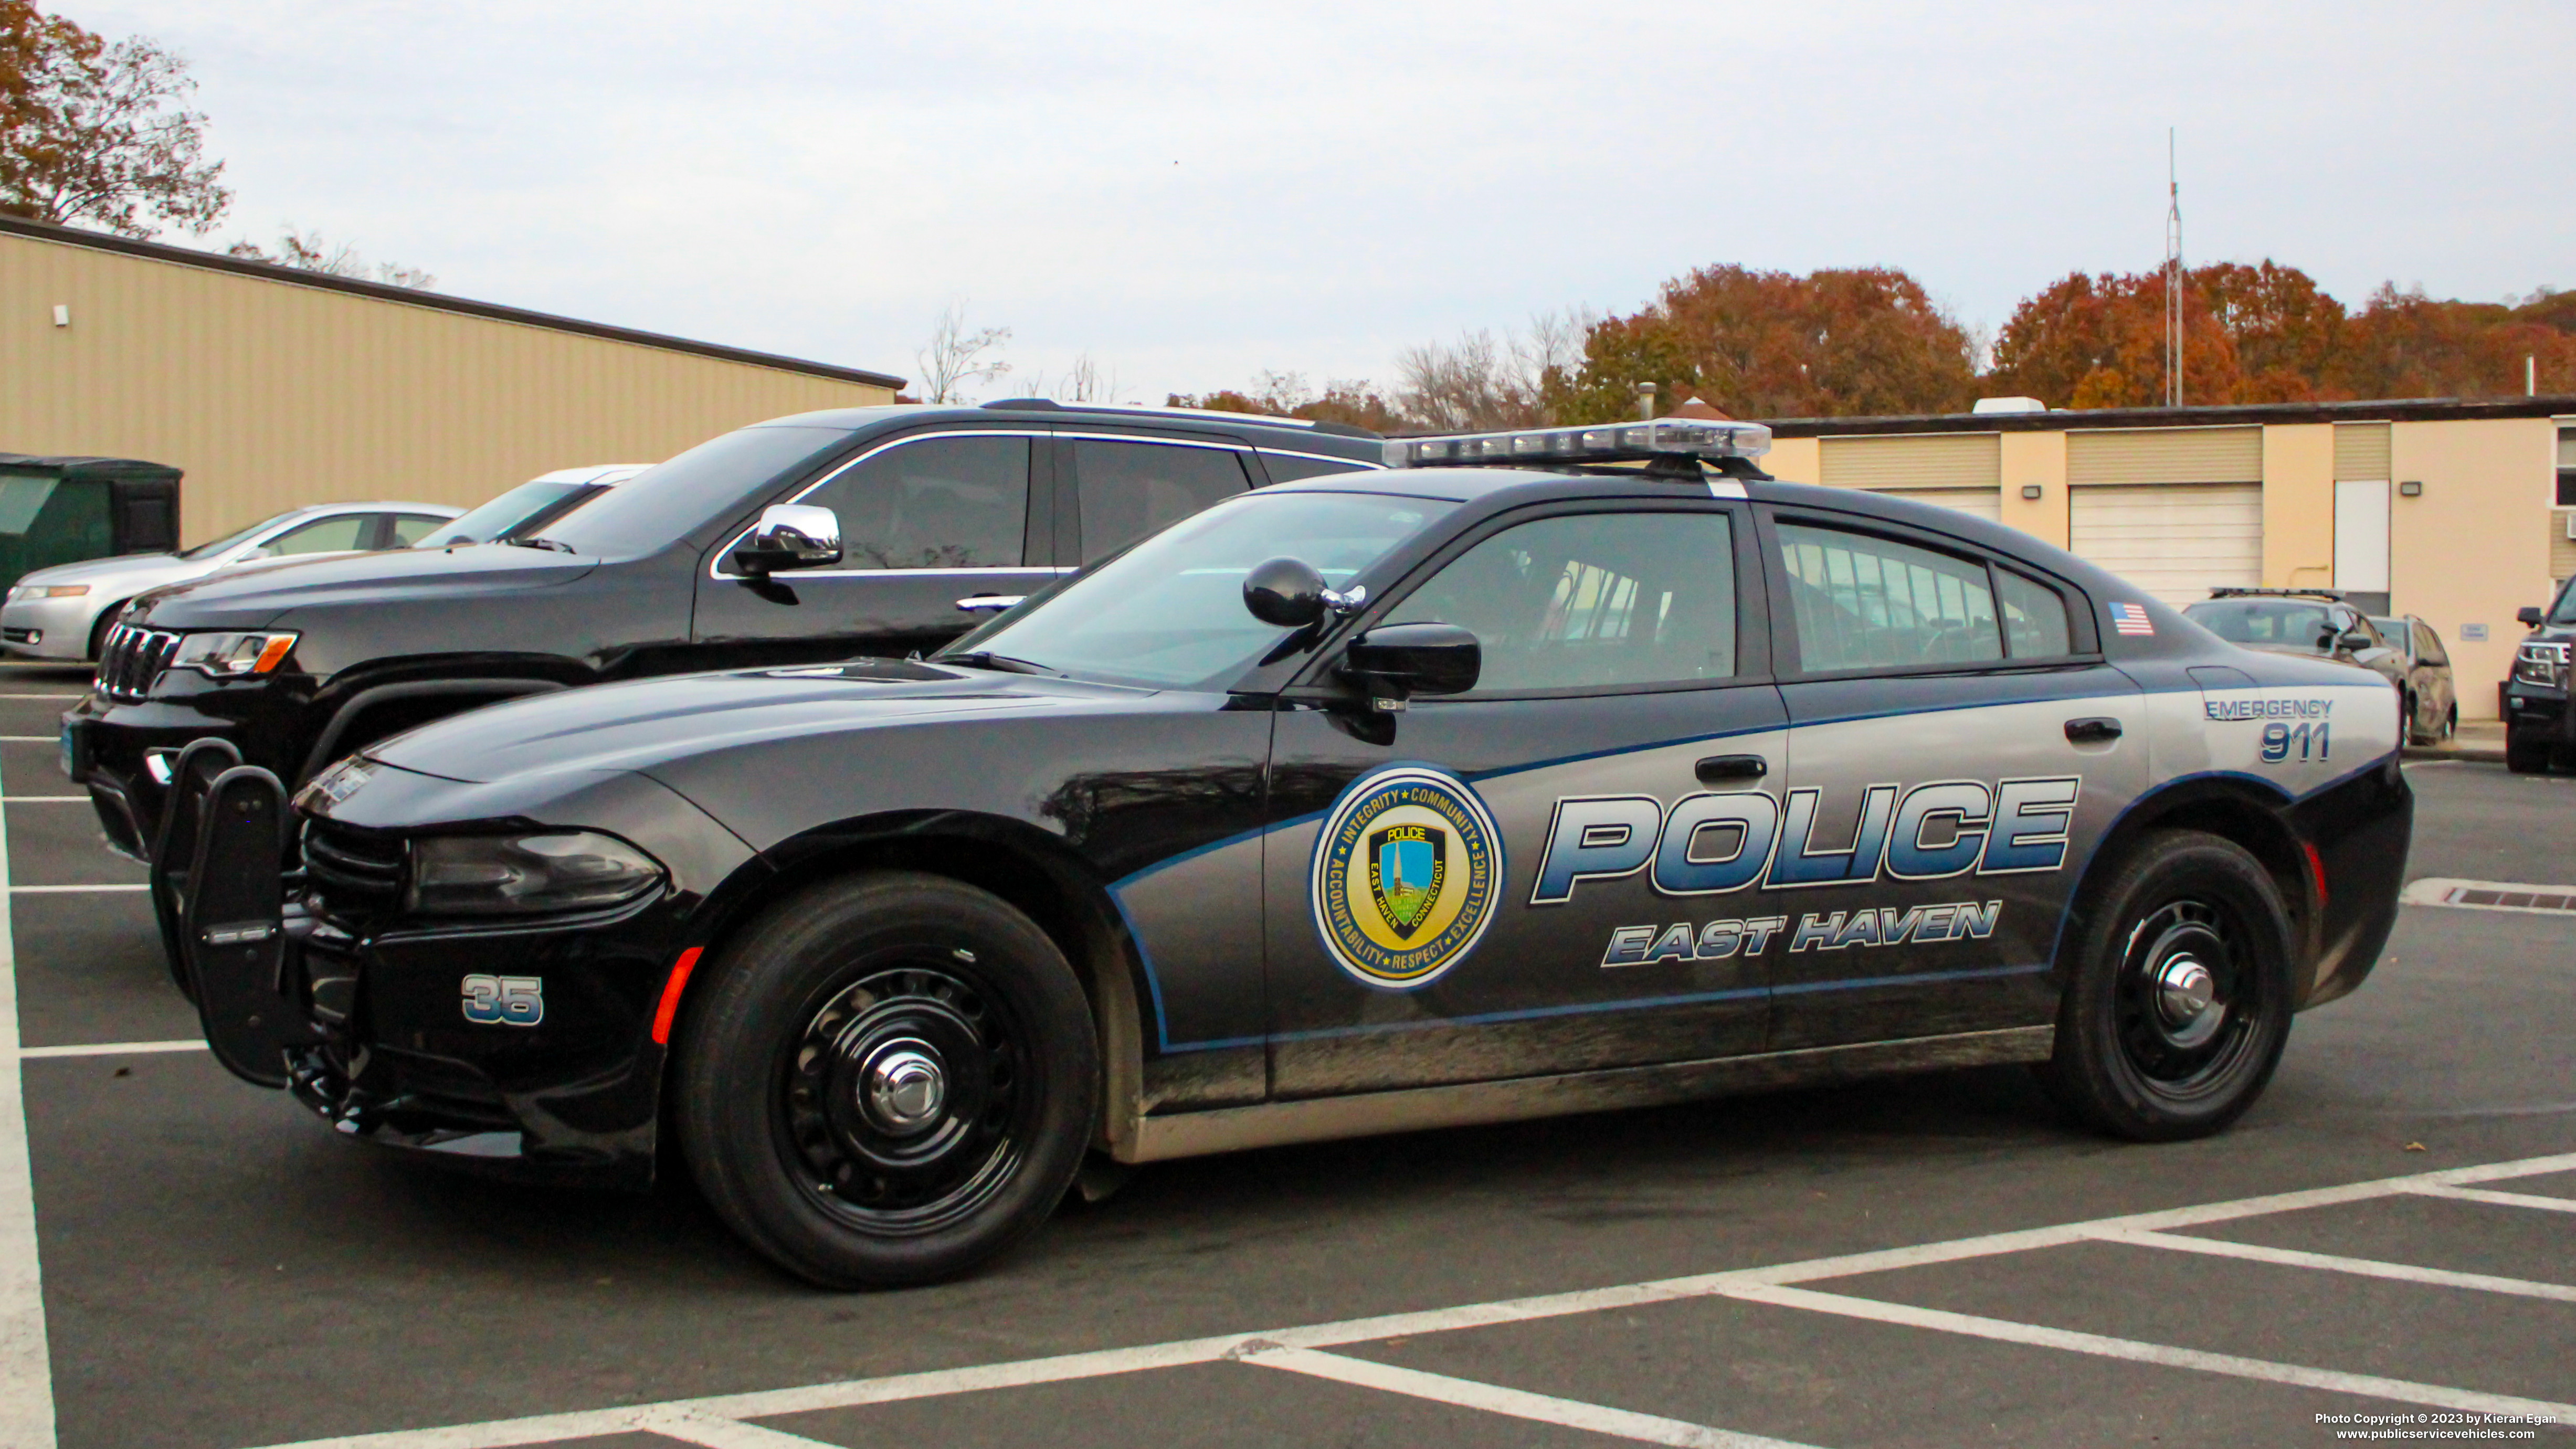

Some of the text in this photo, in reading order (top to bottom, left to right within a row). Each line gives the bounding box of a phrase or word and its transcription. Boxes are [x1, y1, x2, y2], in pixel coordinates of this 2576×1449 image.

[2204, 700, 2334, 720] EMERGENCY
[2261, 723, 2330, 763] 911
[1342, 790, 1399, 843] INTEGRITY
[1388, 827, 1425, 841] POLICE
[1411, 788, 1478, 841] COMMUNITY
[1529, 775, 2082, 904] POLICE
[1330, 859, 1384, 964] ACCOUNTABILITY
[1371, 863, 1398, 928] EAST HAVEN
[1412, 860, 1443, 927] CONNECTICUT
[1451, 851, 1485, 939] EXCELLENCE
[1392, 939, 1443, 969] RESPECT
[1600, 900, 2002, 967] EAST HAVEN
